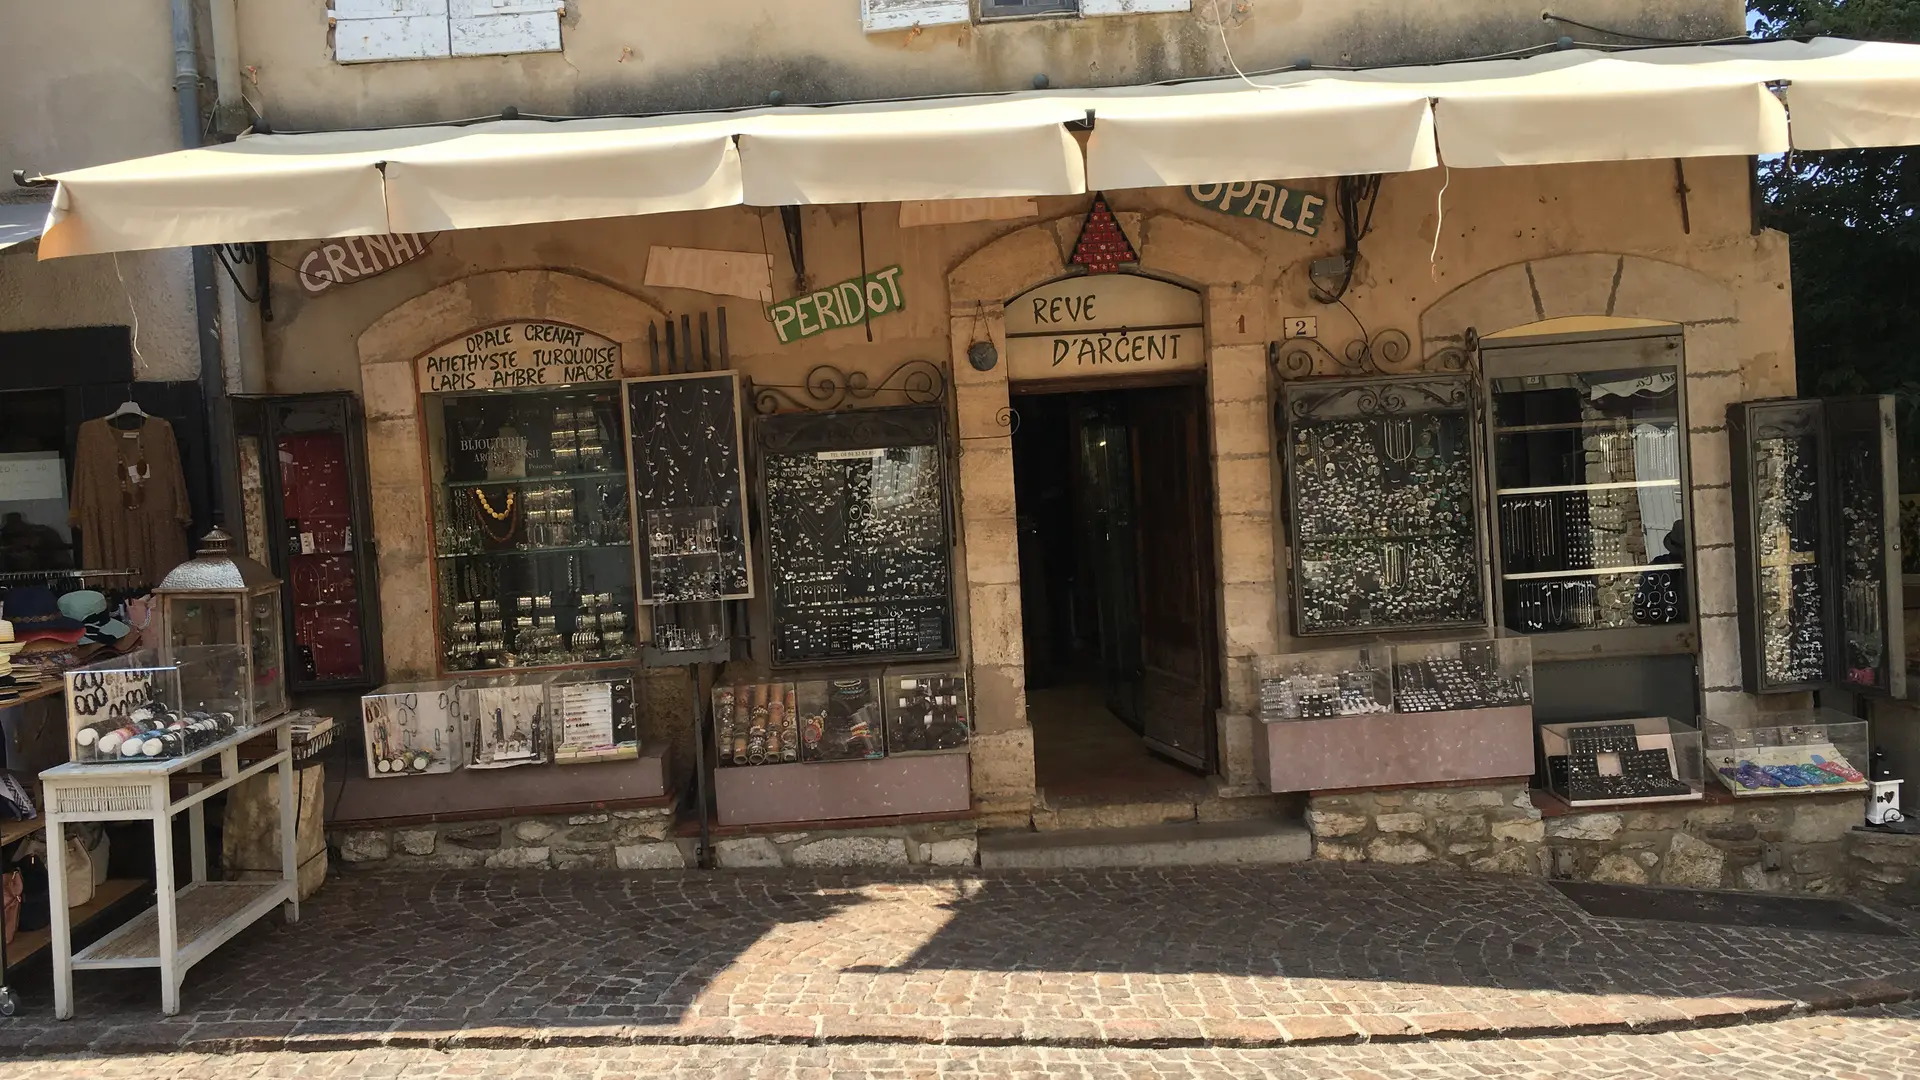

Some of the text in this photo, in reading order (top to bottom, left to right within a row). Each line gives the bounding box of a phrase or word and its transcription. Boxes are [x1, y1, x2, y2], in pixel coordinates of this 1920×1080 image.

[1190, 181, 1324, 235] OPALE
[771, 268, 900, 341] PERIDOT
[1033, 295, 1096, 324] REVE
[1236, 314, 1246, 334] 1
[1295, 320, 1307, 336] 2
[467, 325, 584, 353] OPALE GRENAT
[1052, 334, 1181, 367] D'ARGENT
[427, 346, 617, 373] AMETHYSTE TURQUOISE
[431, 364, 615, 391] LAPIS AMBRE NACRE
